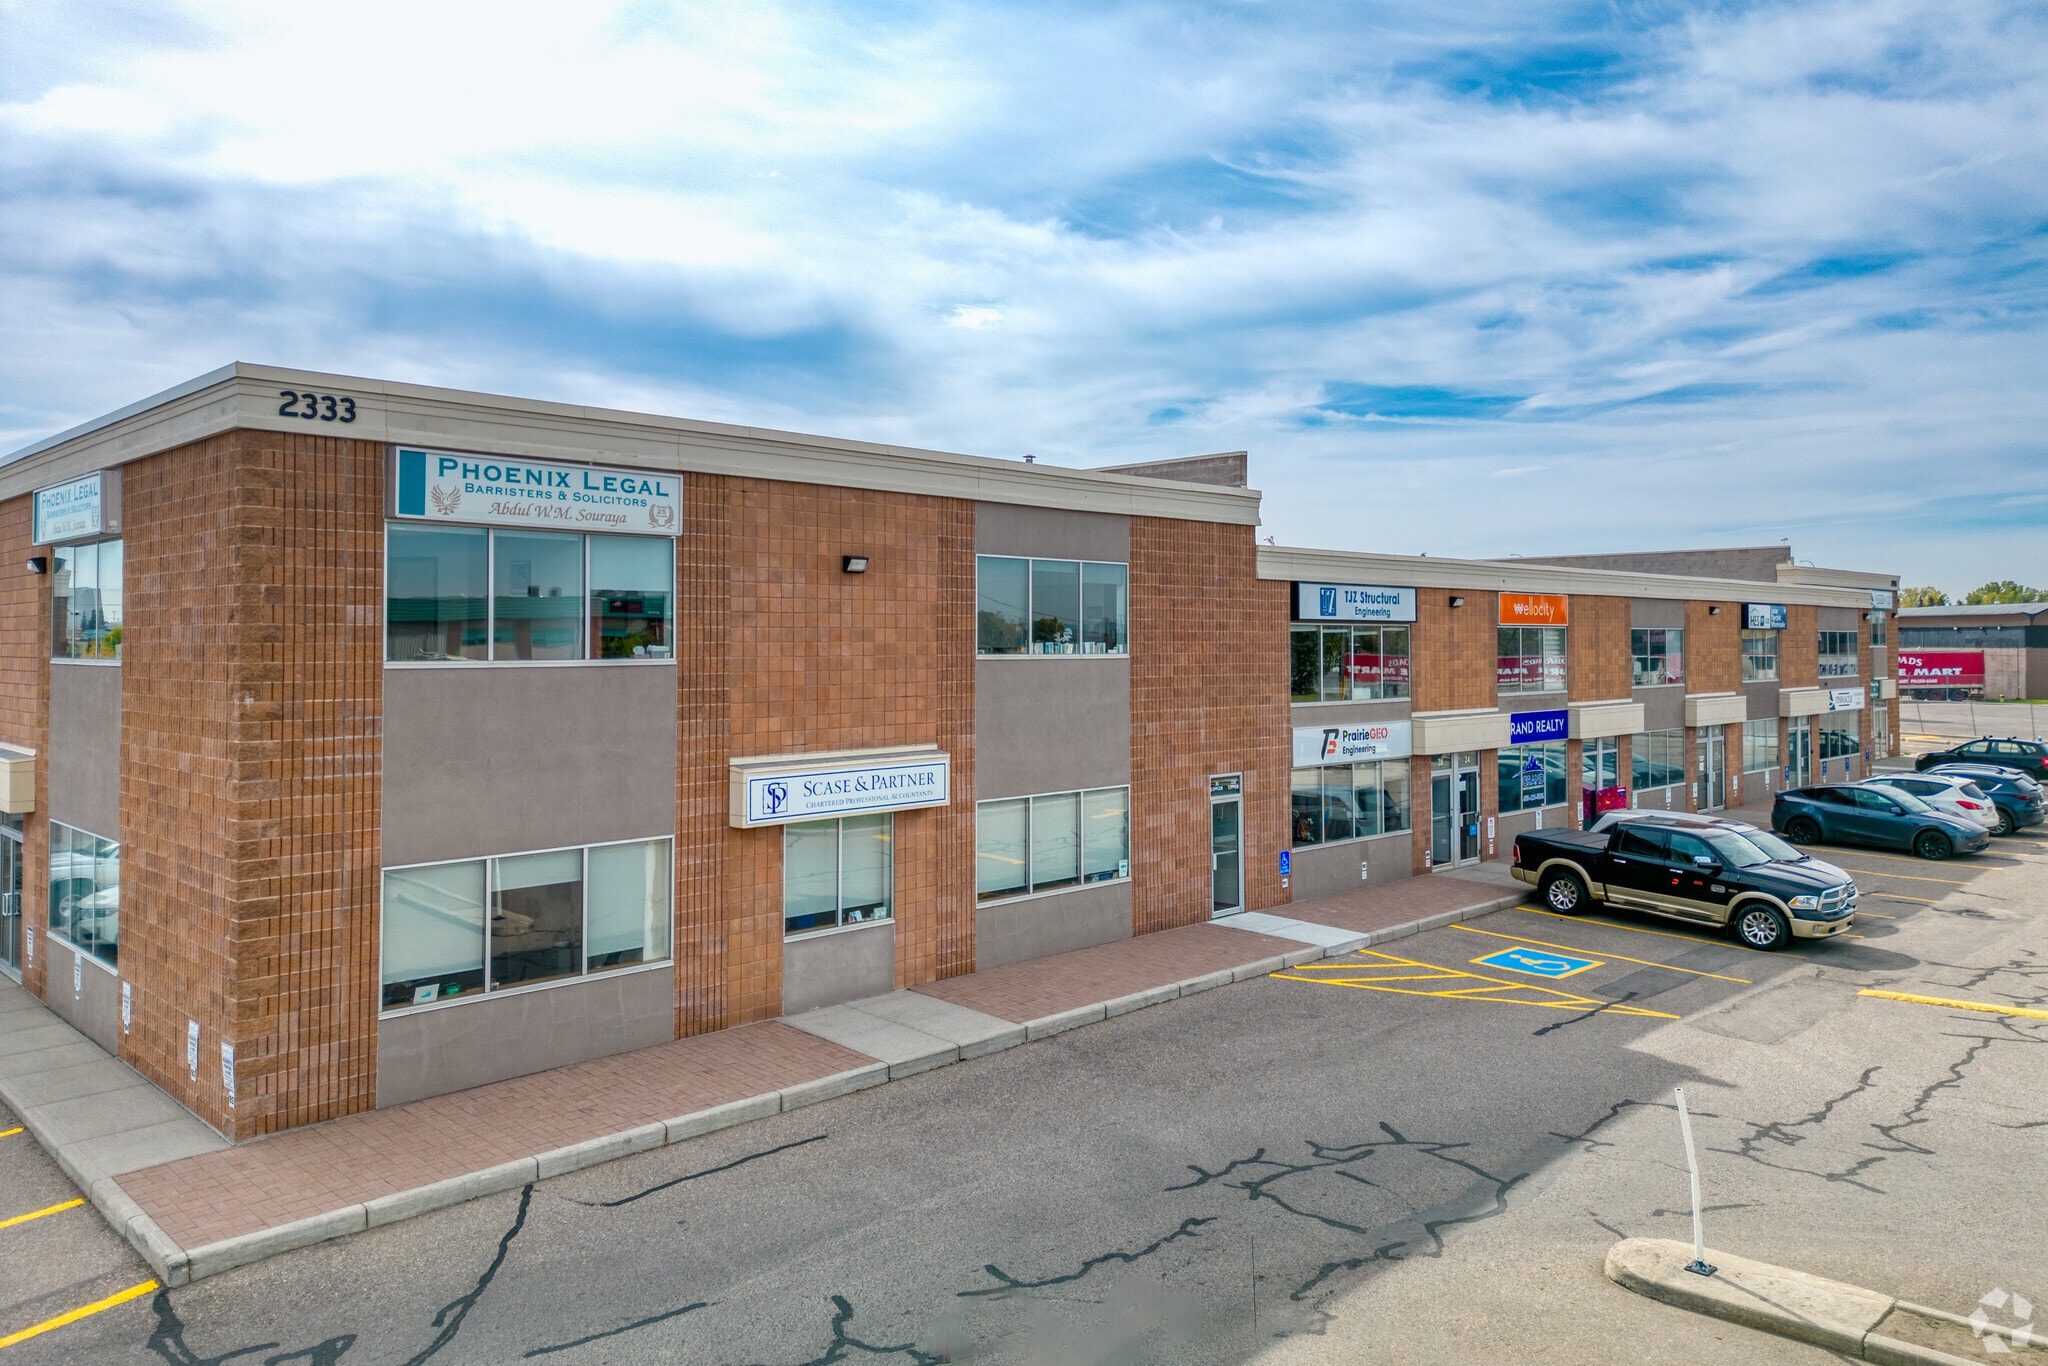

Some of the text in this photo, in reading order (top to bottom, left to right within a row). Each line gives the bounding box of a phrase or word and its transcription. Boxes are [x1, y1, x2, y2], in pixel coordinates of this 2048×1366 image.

[278, 390, 357, 424] 2333
[438, 457, 670, 499] PHOENIX LEGAL
[41, 482, 98, 510] PHOENIX LEGAL
[464, 482, 648, 508] BARRISTERS & SOLICITORS
[488, 501, 531, 518] Abdul
[576, 508, 628, 527] Souraya
[1344, 590, 1400, 605] TJZ Structural
[1354, 606, 1391, 618] Engineering
[1914, 668, 1962, 676] MART
[1343, 727, 1389, 742] PrairieGEO
[1536, 718, 1565, 733] REALTY
[1343, 743, 1376, 756] Engineering
[803, 771, 936, 798] SCASE & PARTNER
[805, 789, 934, 809] CHARTERED PROFESSIONAL ACCOUNTANTS
